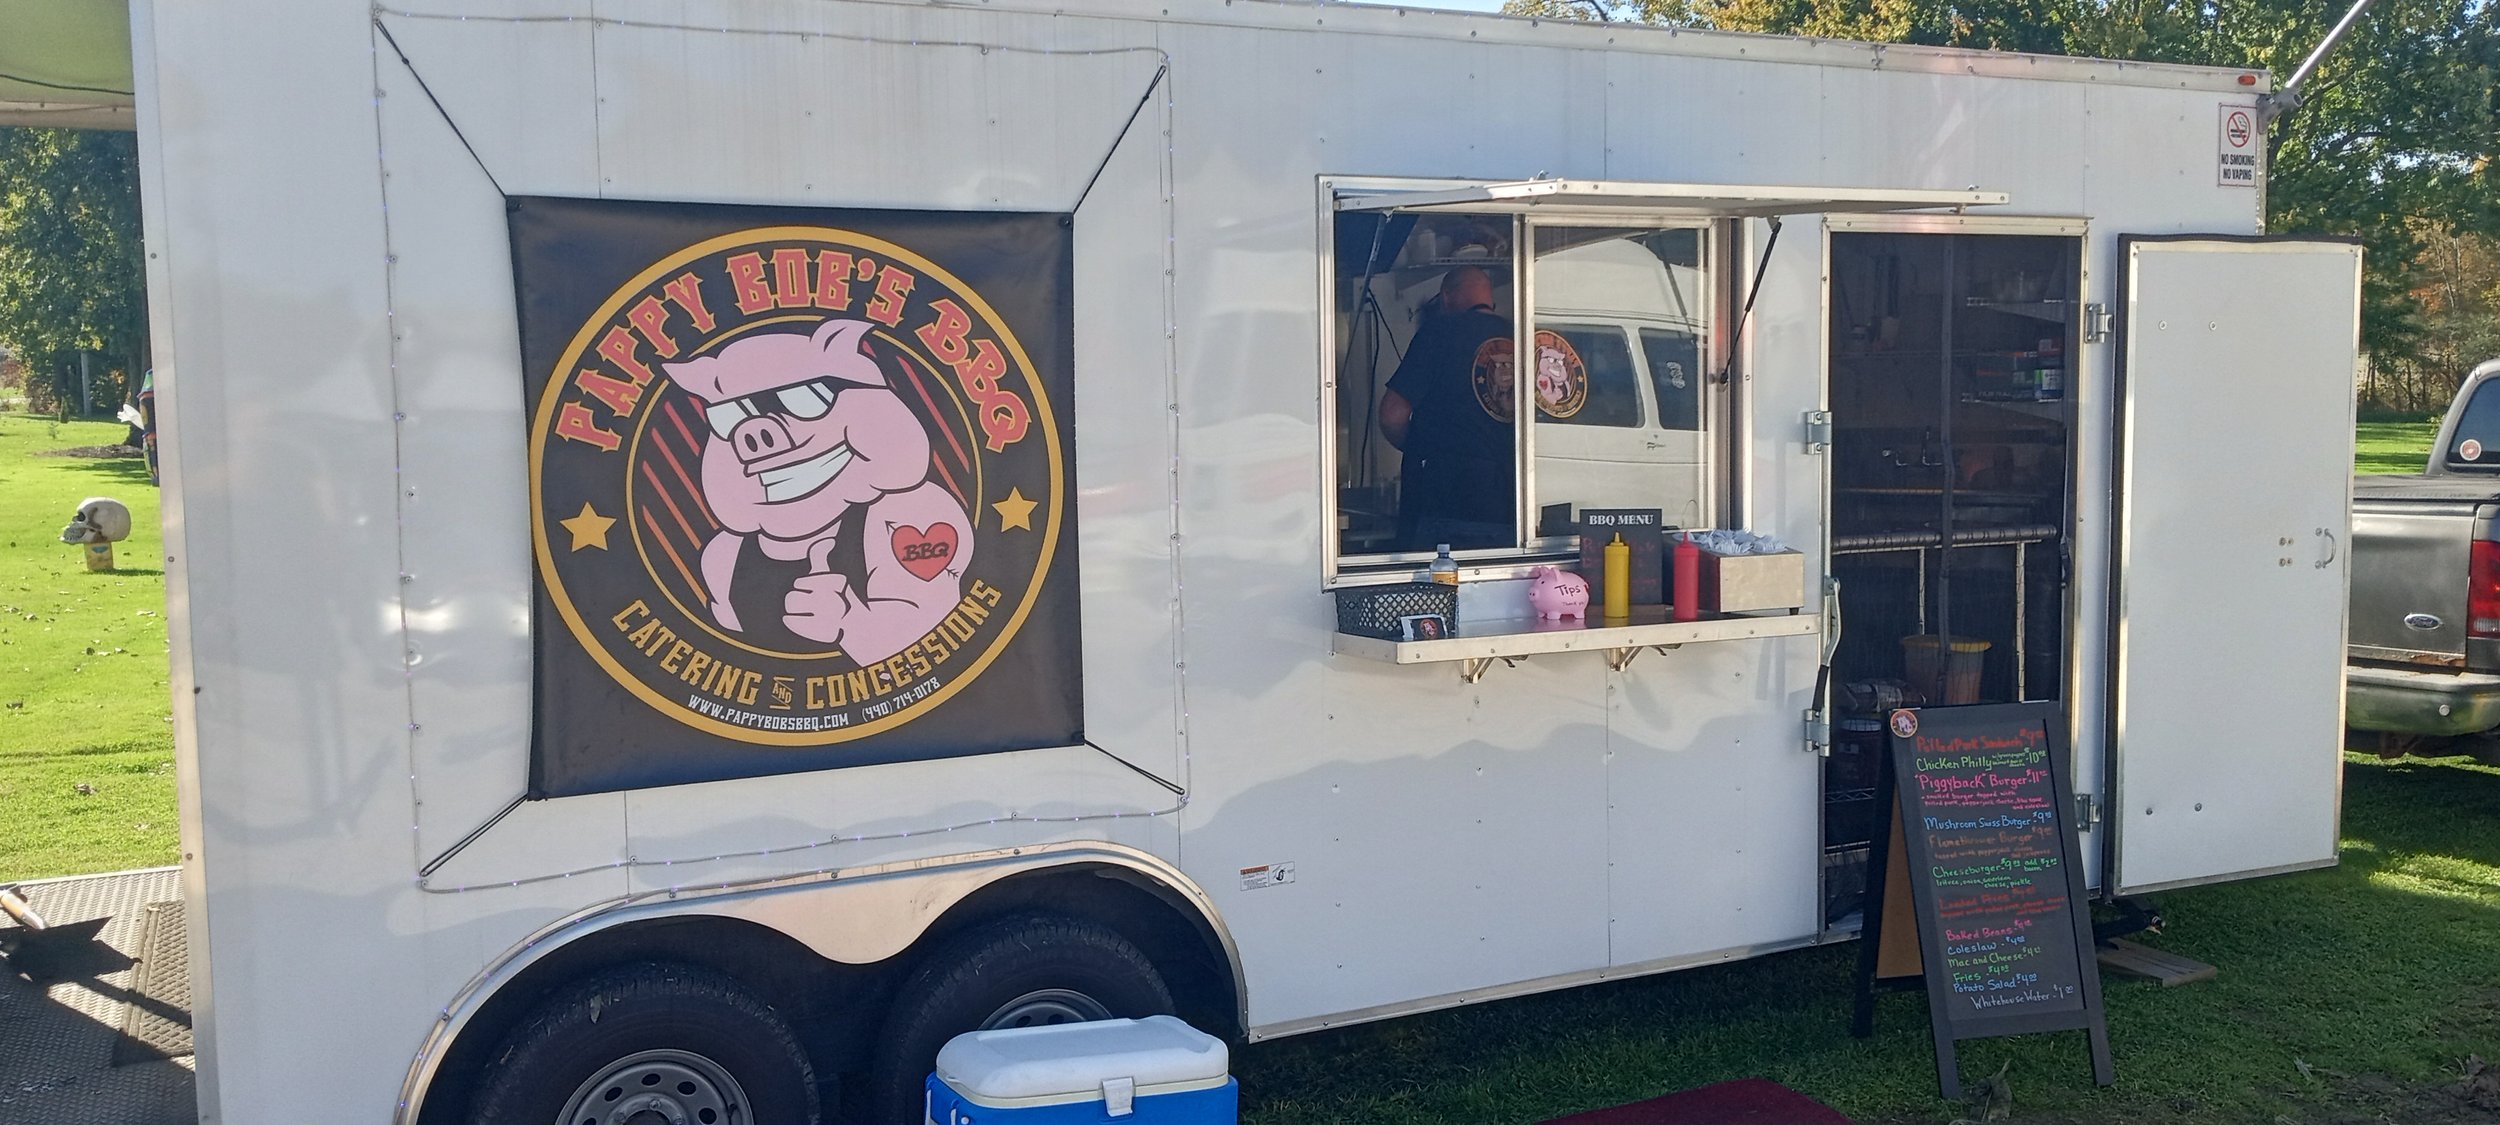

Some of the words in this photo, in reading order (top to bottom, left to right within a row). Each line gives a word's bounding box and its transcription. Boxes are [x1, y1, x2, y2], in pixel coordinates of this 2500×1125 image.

[2221, 154, 2229, 165] NO
[2230, 154, 2254, 166] SMOKING
[2223, 168, 2231, 179] NO
[2232, 168, 2252, 180] VAPING
[555, 272, 716, 452] PAPPY
[725, 248, 915, 328] BOB'S
[914, 298, 1032, 453] BBQ
[1589, 515, 1615, 526] BBQ
[1618, 515, 1654, 525] MENU
[902, 541, 949, 561] BBQ
[1554, 584, 1581, 597] Tips
[612, 599, 763, 705] CATERING
[772, 682, 792, 704] AND
[806, 579, 1002, 710] CONCESSIONS
[688, 694, 849, 732] WWW.PAPPYBOBSBBQ.COM
[861, 700, 893, 722] (440)
[893, 676, 940, 709] 714-0178
[1916, 754, 1960, 772] Chicken
[1961, 755, 1992, 771] Philly
[1989, 774, 2026, 789] Burger
[1923, 817, 1977, 831] Mushroom
[2001, 815, 2031, 829] Burger
[1999, 831, 2032, 845] Burger
[1933, 864, 2000, 878] Cheeseburger
[1945, 929, 1979, 941] Baked
[1982, 926, 2013, 938] Beans
[1947, 942, 1996, 956] Coleslaw
[1948, 957, 1970, 968] Mac
[1973, 955, 1987, 965] and
[1989, 952, 2023, 964] Cheese
[1953, 972, 1981, 983] Fries
[1953, 982, 1984, 993] Potato
[1988, 978, 2016, 991] Salad
[2024, 990, 2050, 1002] Water
